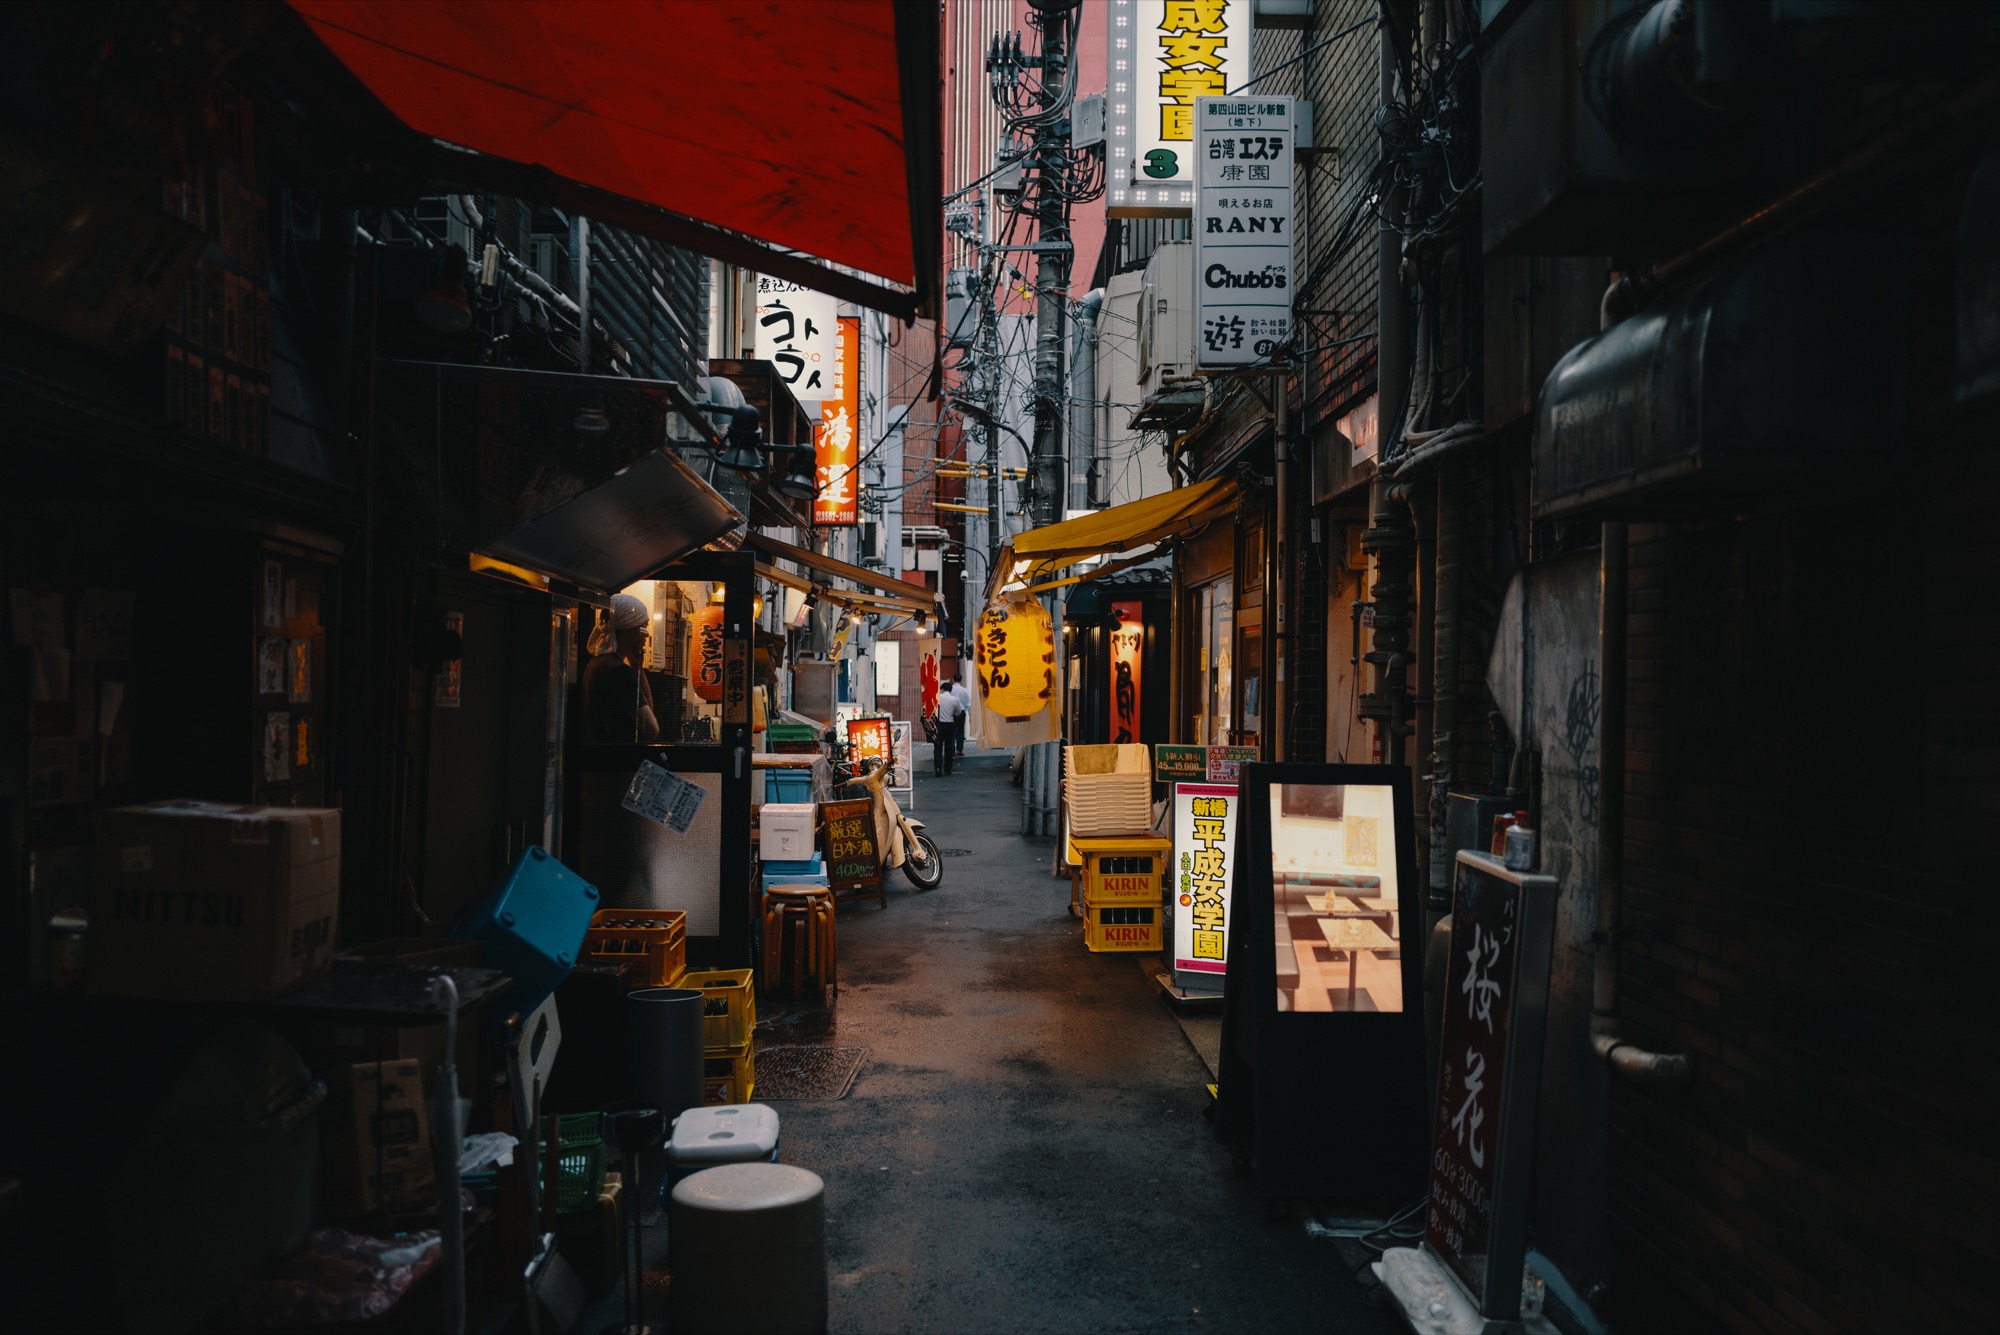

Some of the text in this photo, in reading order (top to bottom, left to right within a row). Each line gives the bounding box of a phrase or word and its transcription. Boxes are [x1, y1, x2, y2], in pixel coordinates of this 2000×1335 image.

[1208, 103, 1286, 116] 第四山田ビル新館
[1209, 136, 1284, 160] 台湾 エステ
[1143, 149, 1179, 179] 3
[1218, 199, 1273, 209] 唄えるお店
[1206, 216, 1286, 233] RANY
[1204, 315, 1246, 352] 遊
[1258, 342, 1273, 355] B1
[817, 406, 855, 505] 鴻運
[986, 608, 1011, 688] やきとん
[727, 659, 745, 707] 営業中
[1192, 797, 1228, 818] 新橋
[830, 820, 866, 840] 厳選
[833, 840, 873, 859] 日本酒
[1104, 877, 1149, 891] KIRIN
[1191, 818, 1227, 961] 平成女学園
[114, 888, 245, 928] NITTSU
[1105, 927, 1150, 941] KIRIN
[1452, 922, 1501, 1170] 桜花
